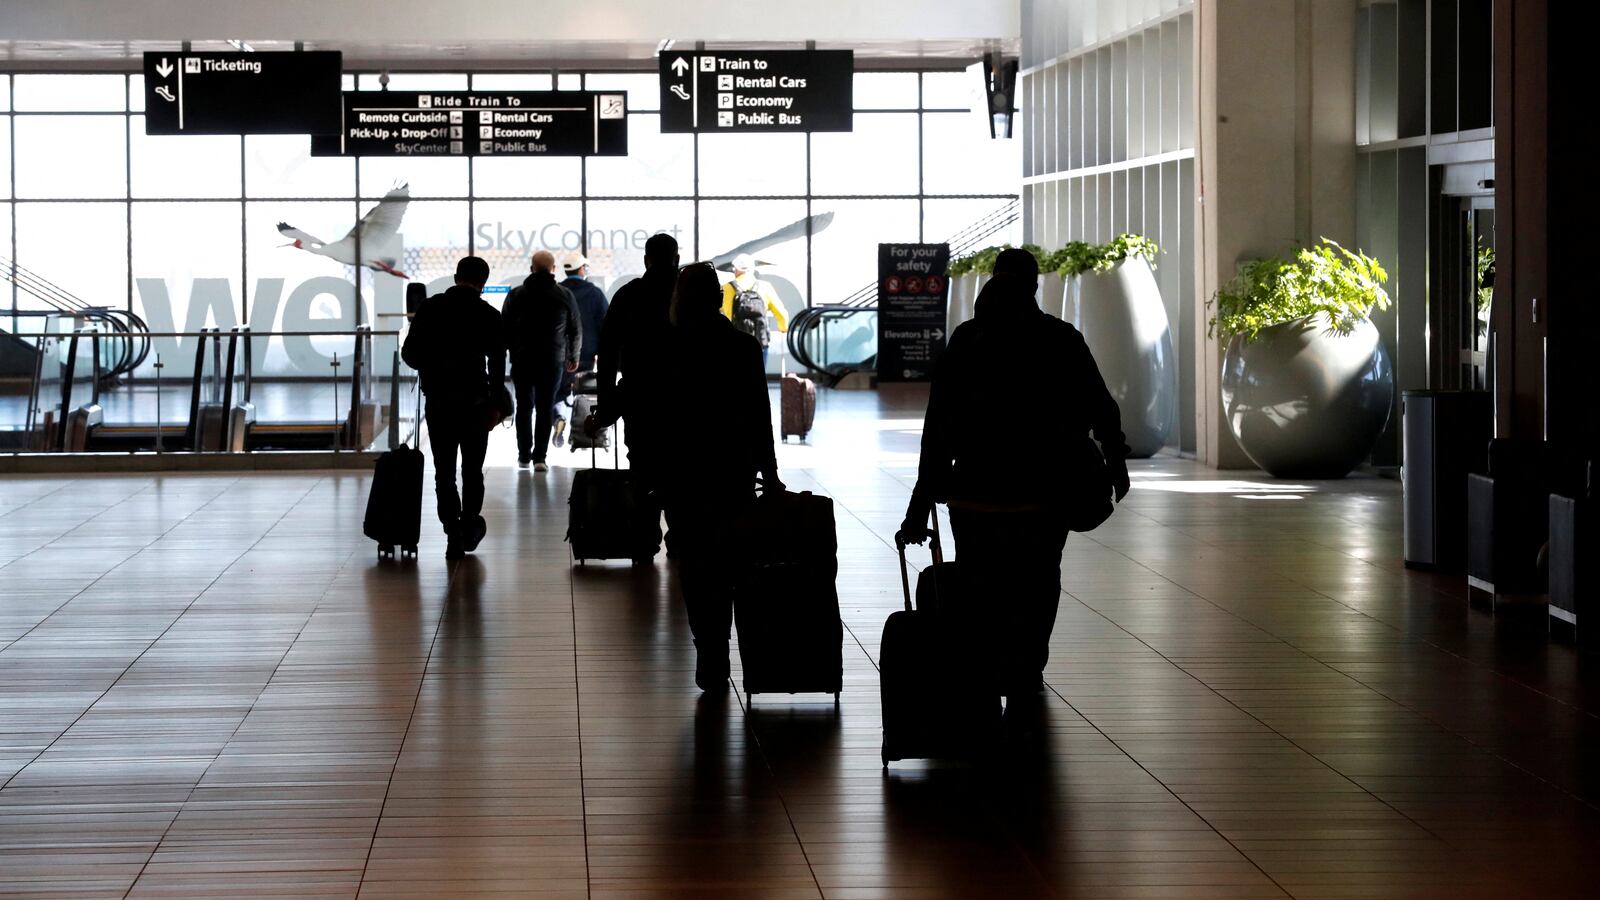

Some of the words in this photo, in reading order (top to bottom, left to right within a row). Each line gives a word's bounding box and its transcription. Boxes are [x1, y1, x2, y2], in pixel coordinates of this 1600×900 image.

[203, 59, 262, 74] Ticketing
[718, 57, 750, 70] Train
[753, 58, 768, 70] to
[735, 76, 776, 89] Rental
[779, 76, 807, 89] Cars
[433, 96, 462, 107] Ride
[468, 96, 501, 107] Train
[506, 96, 521, 107] To
[736, 95, 793, 110] Economy
[359, 113, 400, 123] Remote
[401, 112, 448, 123] Curbside
[494, 112, 528, 123] Rental
[530, 112, 553, 123] Cars
[737, 112, 774, 125] Public
[779, 113, 801, 125] Bus
[350, 128, 389, 141] Pick-Up
[401, 127, 448, 141] Drop-Off
[494, 128, 542, 140] Economy
[394, 142, 448, 154] SkyCenter
[494, 141, 525, 153] Public
[528, 142, 547, 153] Bus
[476, 221, 683, 257] SkyConnet
[890, 247, 909, 257] For
[911, 248, 938, 259] your
[896, 260, 932, 273] safety
[884, 329, 921, 339] Elevators
